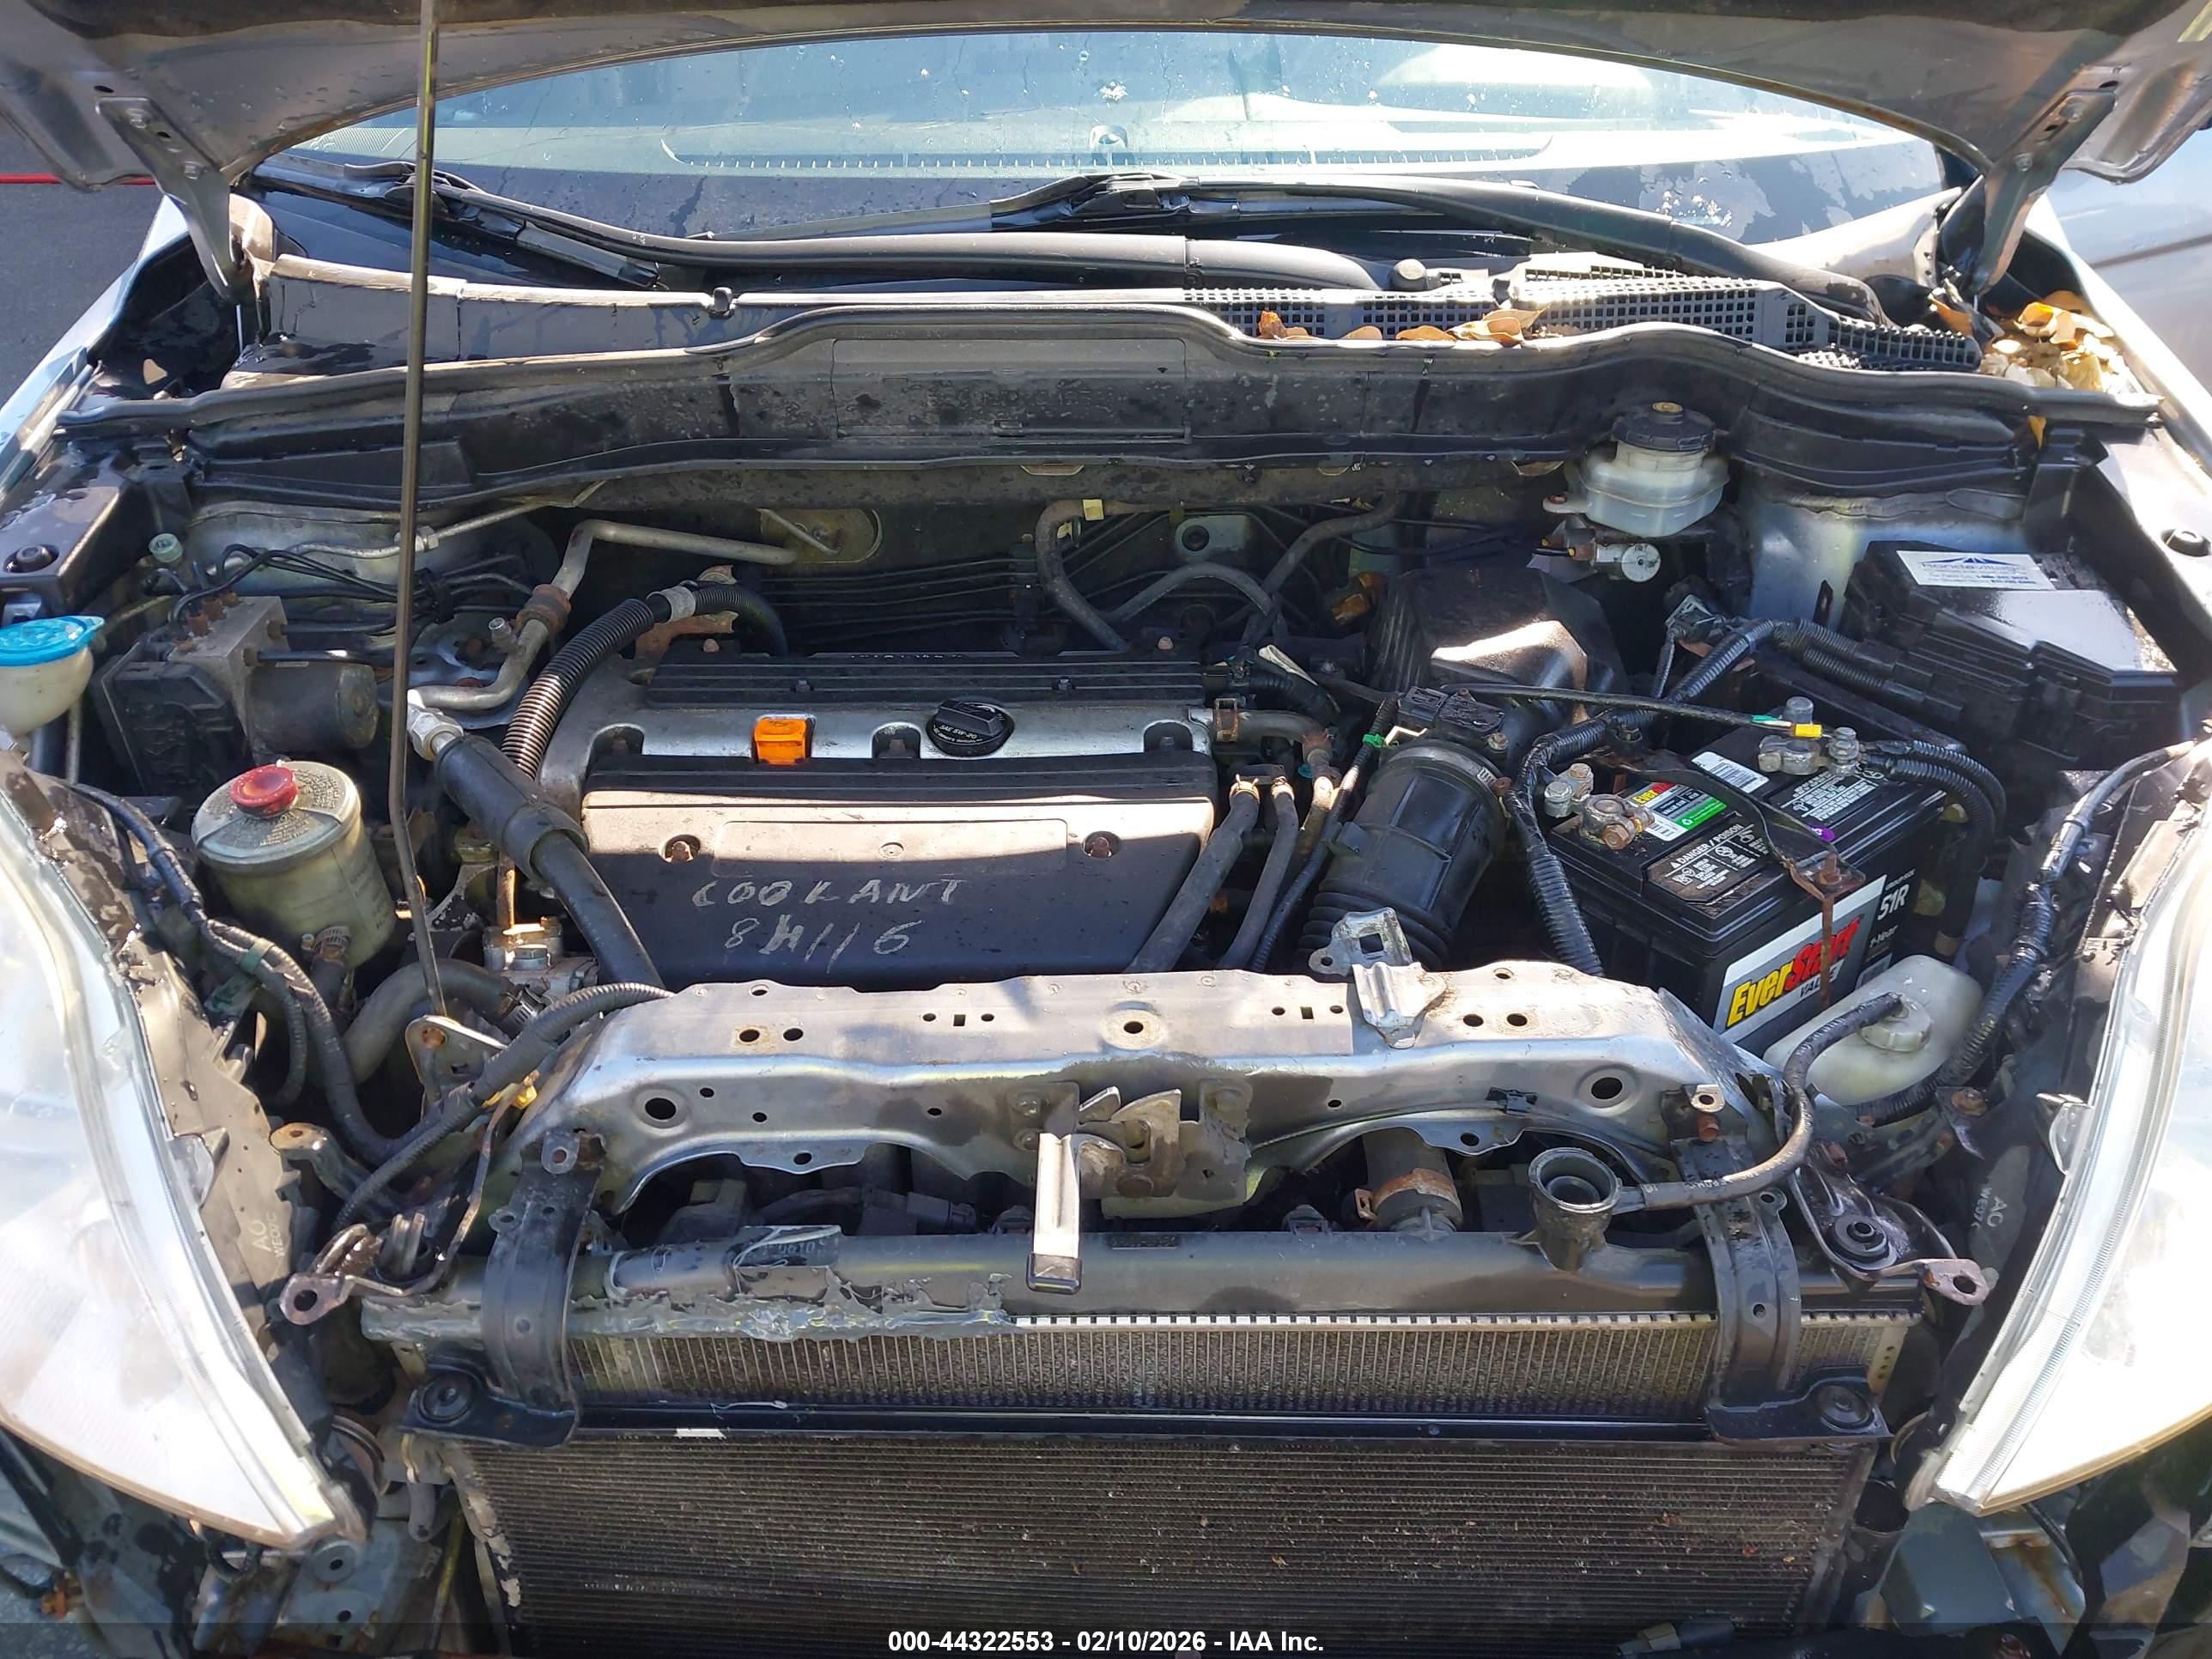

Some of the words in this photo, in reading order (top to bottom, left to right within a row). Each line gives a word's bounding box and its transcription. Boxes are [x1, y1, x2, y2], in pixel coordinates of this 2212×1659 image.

[1675, 842, 1711, 865] DANGER
[1712, 823, 1745, 843] POISON
[1877, 884, 1910, 921] 51R
